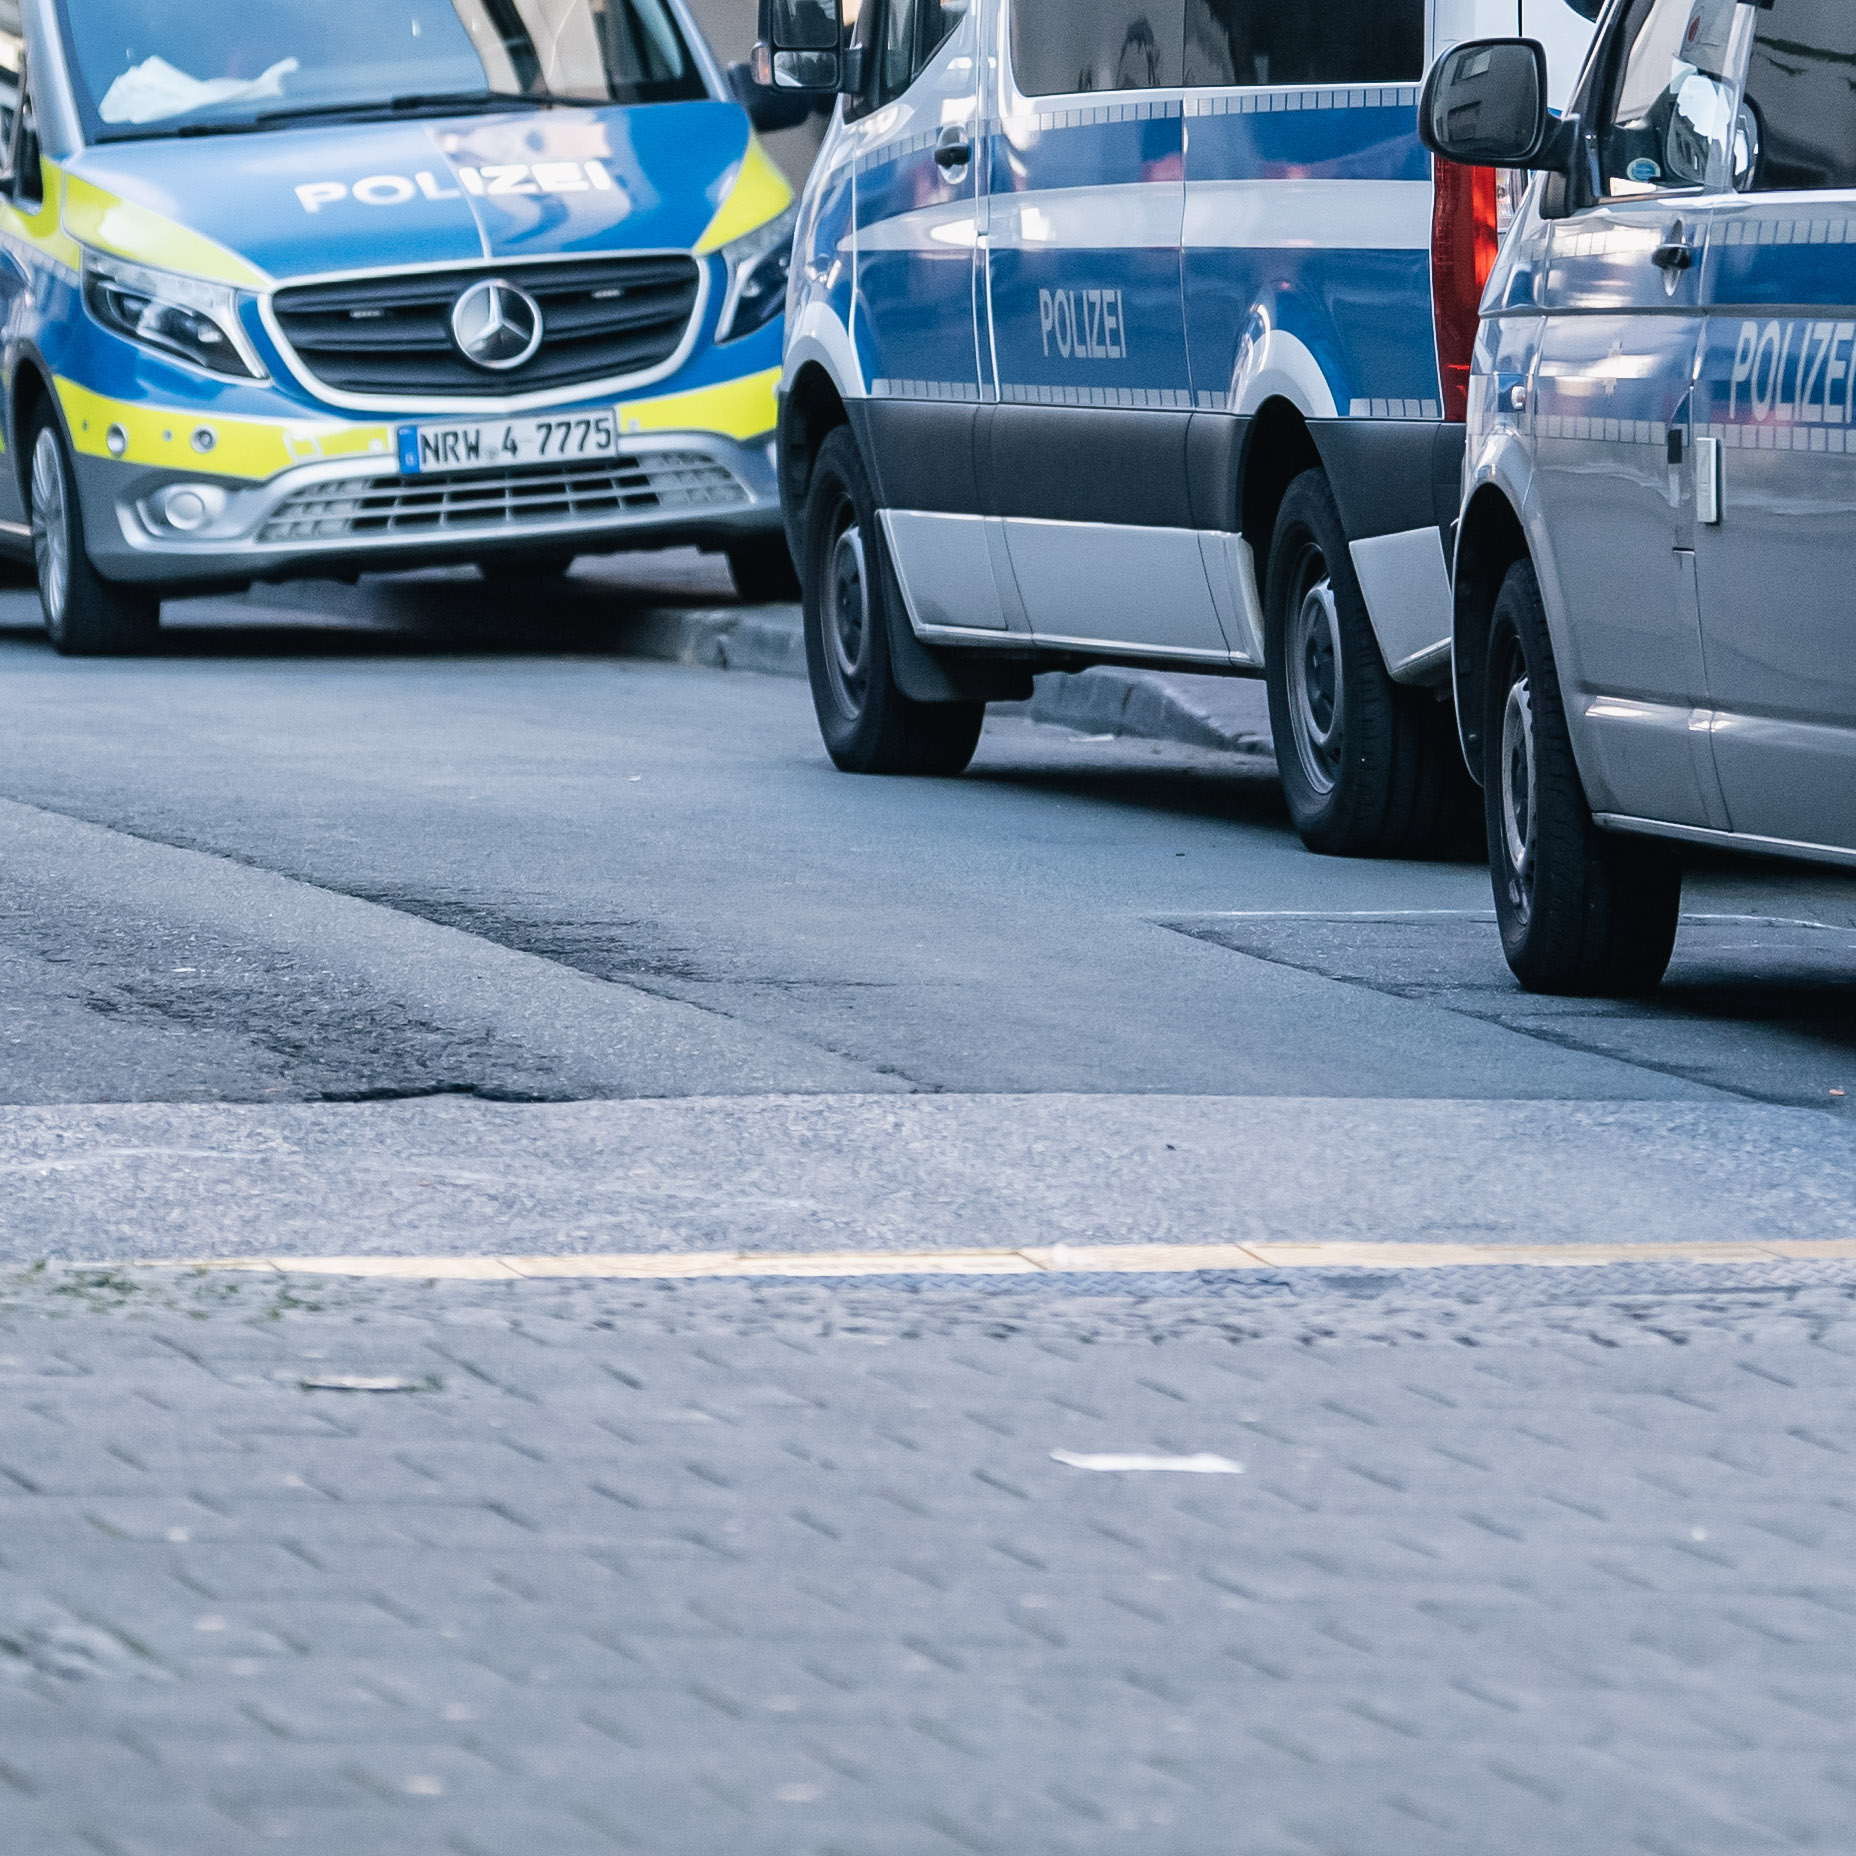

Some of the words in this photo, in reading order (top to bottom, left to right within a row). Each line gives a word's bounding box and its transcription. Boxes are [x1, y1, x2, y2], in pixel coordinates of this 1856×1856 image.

[294, 159, 613, 214] POLIZEI
[1038, 288, 1127, 359] POLIZEI
[420, 428, 480, 465] NRW
